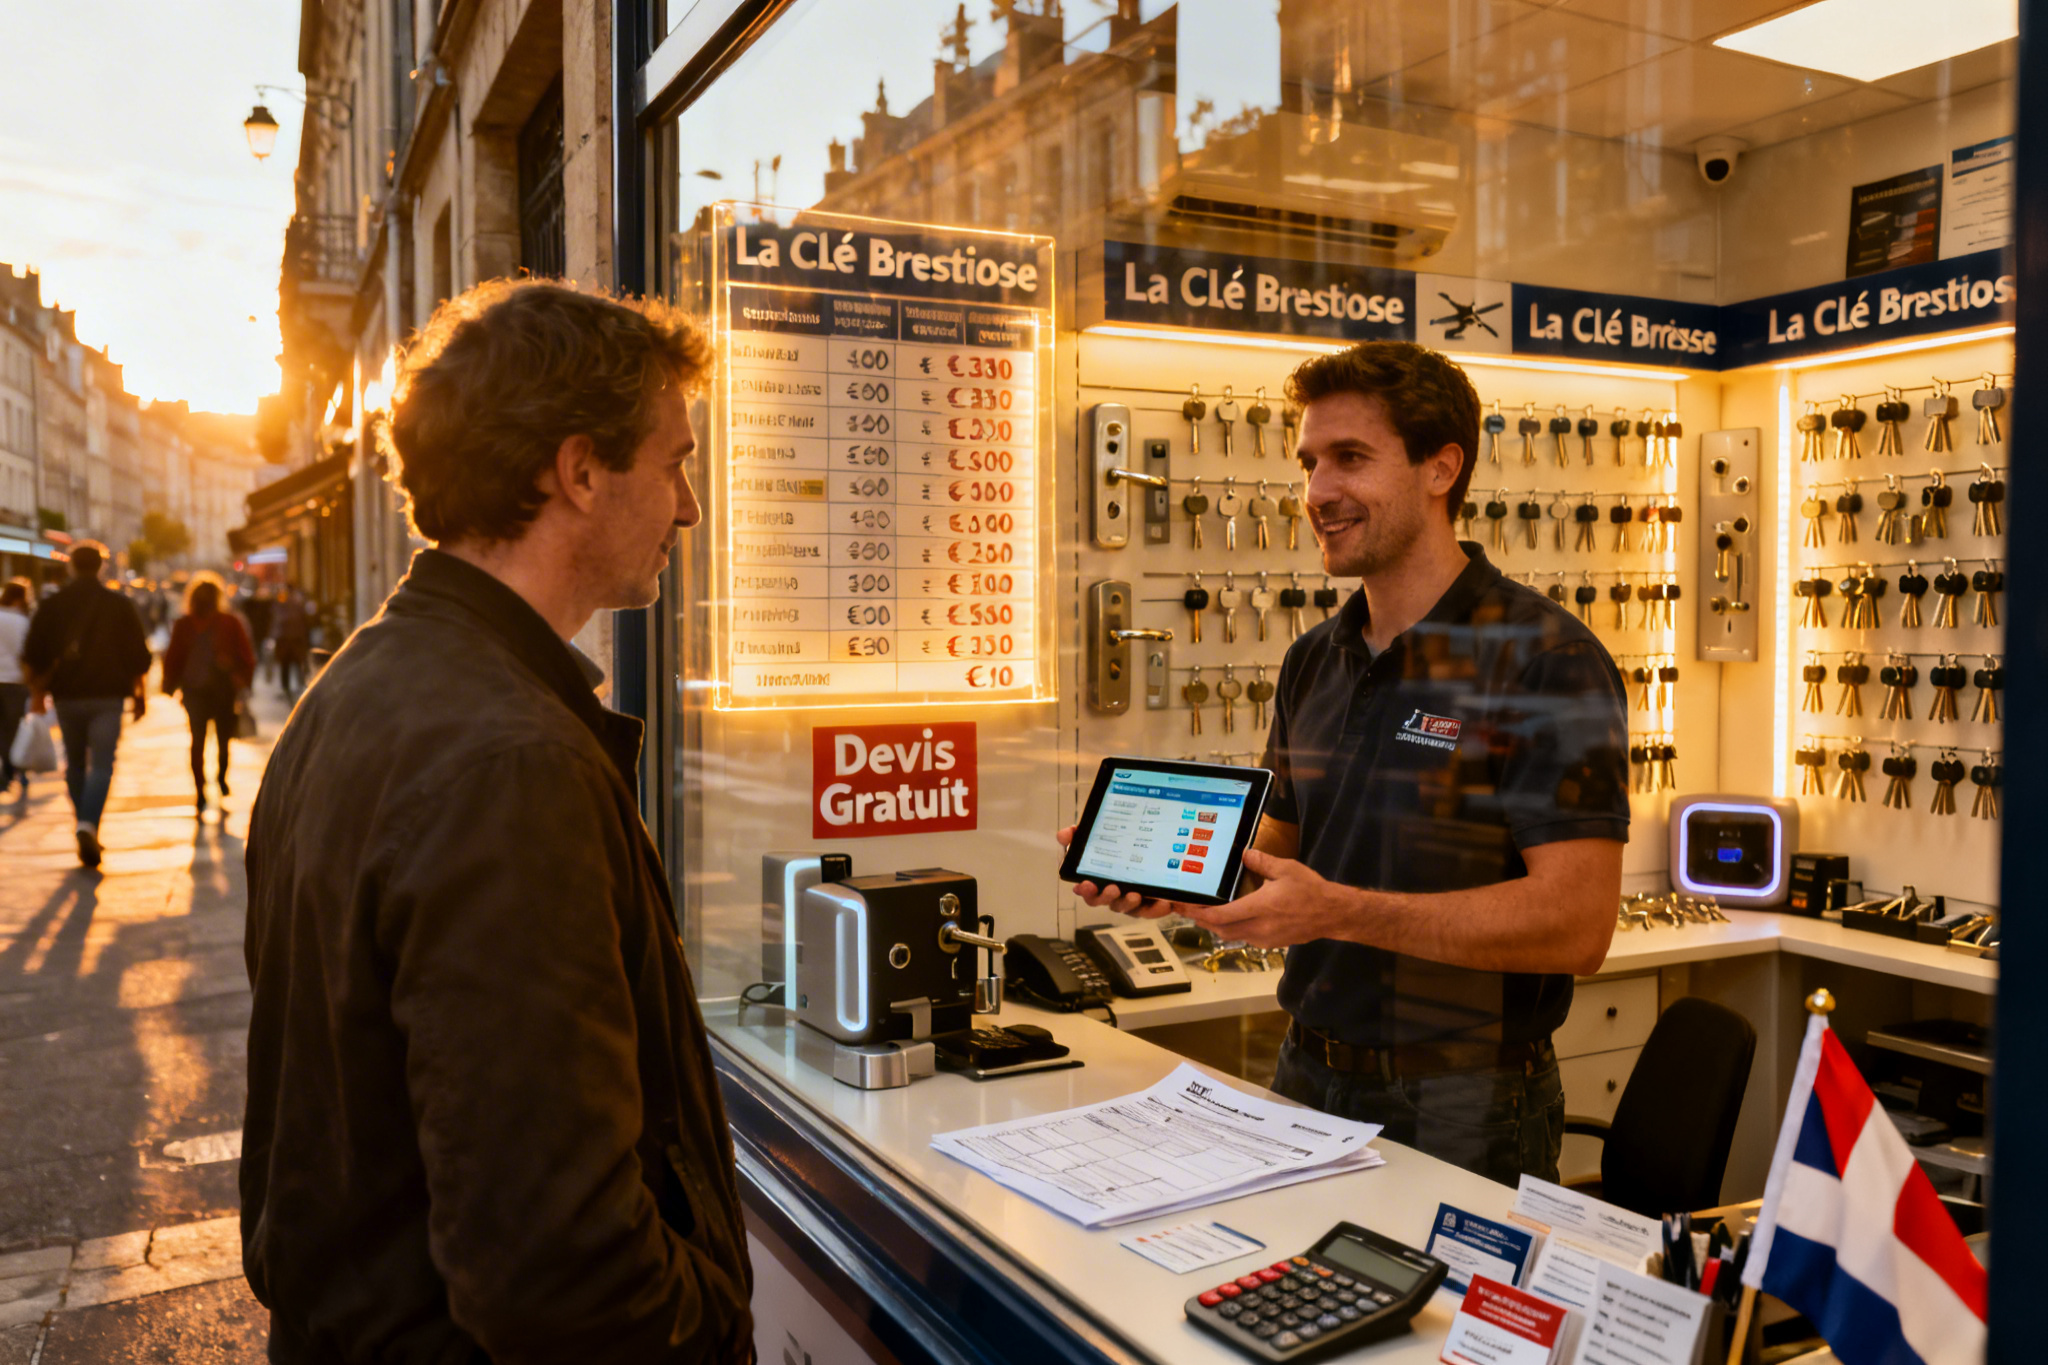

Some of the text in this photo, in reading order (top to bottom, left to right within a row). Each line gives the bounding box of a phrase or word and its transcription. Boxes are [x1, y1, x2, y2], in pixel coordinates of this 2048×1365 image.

[736, 226, 1038, 292] La Clé Brestiose
[1125, 262, 1405, 324] La Clé Brestiose
[1768, 309, 1806, 344] La
[1813, 290, 1870, 336] Clé
[1530, 302, 1563, 340] La
[1572, 307, 1623, 345] Clé
[834, 728, 956, 776] Devis
[820, 777, 970, 826] Gratuit
